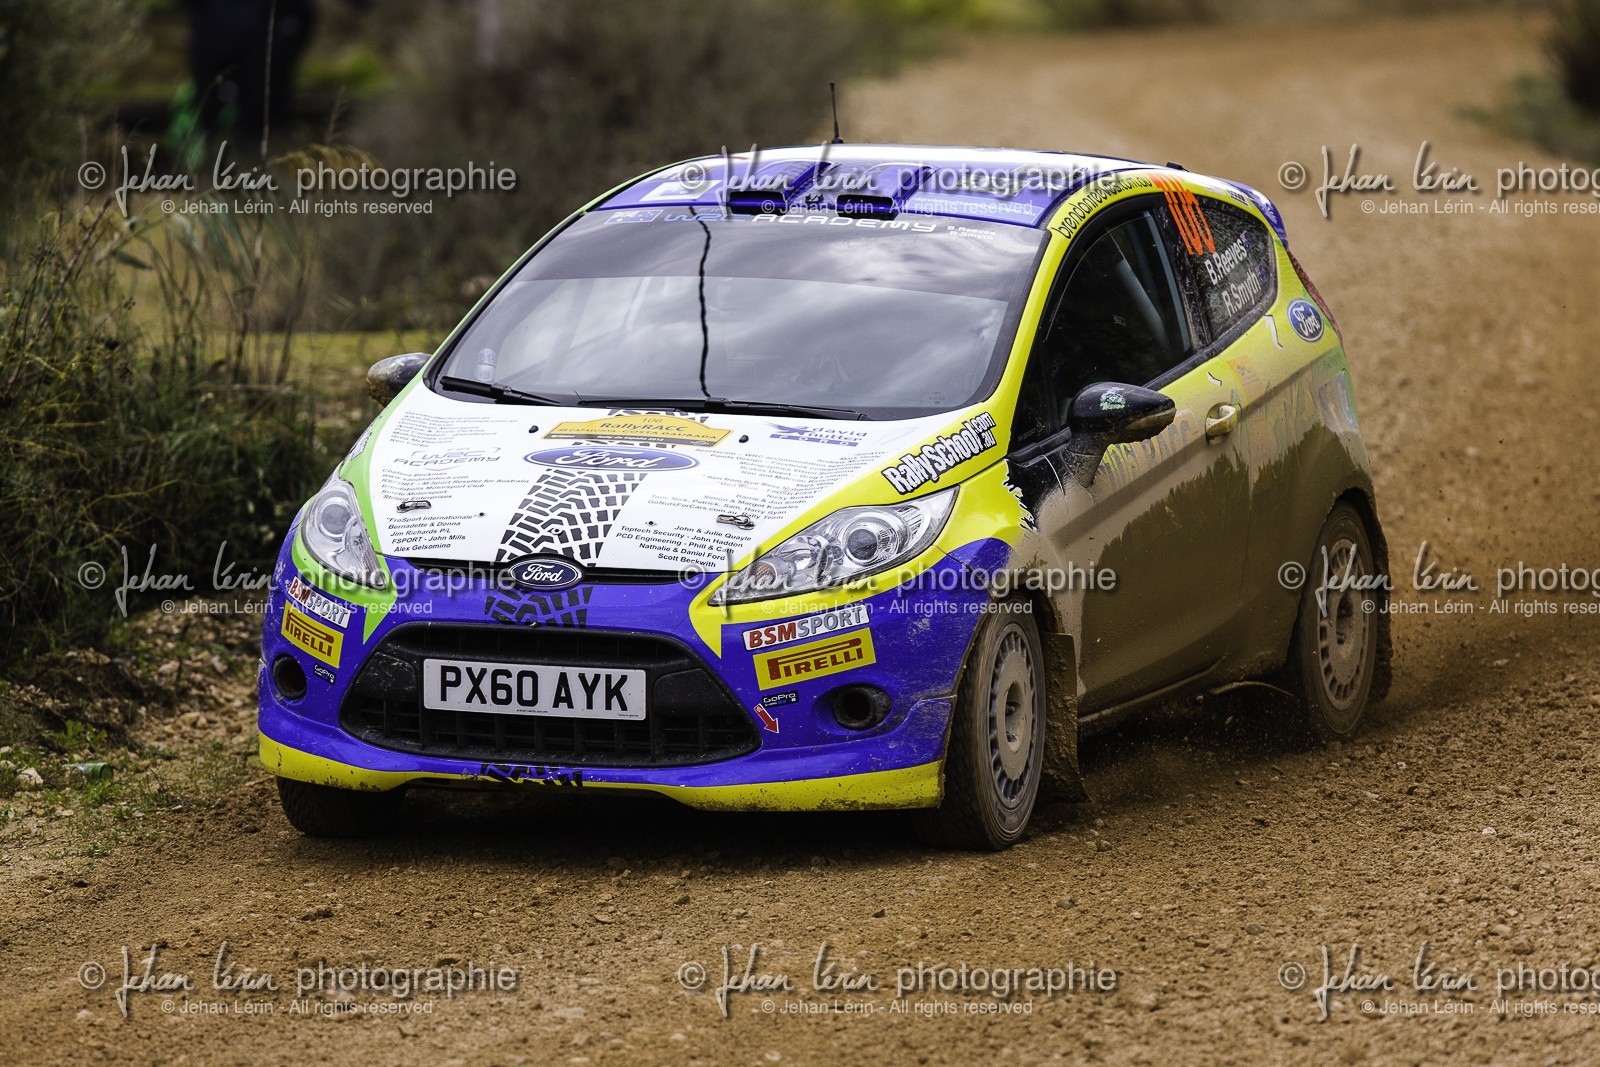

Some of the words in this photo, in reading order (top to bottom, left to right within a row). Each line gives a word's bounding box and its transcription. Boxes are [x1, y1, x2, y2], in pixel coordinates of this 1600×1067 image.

[752, 214, 937, 233] ACADEMY
[1204, 237, 1247, 286] B.Reeves
[1221, 270, 1262, 317] R.Smyth
[1292, 305, 1321, 336] Ford
[600, 423, 688, 432] RallyRACC
[813, 426, 867, 437] david
[780, 435, 849, 446] FORD
[393, 456, 501, 466] ACADEMY
[555, 449, 667, 468] Ford
[391, 536, 423, 544] FSPORT
[621, 525, 651, 534] Toptech
[653, 529, 685, 539] Security
[713, 538, 743, 548] Haddon
[635, 535, 682, 546] Engineering
[703, 529, 723, 537] Julie
[725, 533, 752, 542] Quayle
[411, 542, 451, 551] Gelsomino
[638, 543, 671, 552] Nathalie
[680, 548, 706, 557] Daniel
[706, 553, 726, 561] Ford
[657, 553, 679, 561] Scott
[680, 556, 716, 568] Beckwith
[522, 562, 564, 583] Ford
[290, 578, 349, 625] BSMSPORT
[285, 608, 334, 657] PIRELLI
[749, 607, 863, 648] BSMSPORT
[766, 637, 864, 680] PIRELLI
[440, 665, 539, 707] PX60
[552, 671, 628, 712] AYK
[763, 692, 796, 703] GoPro
